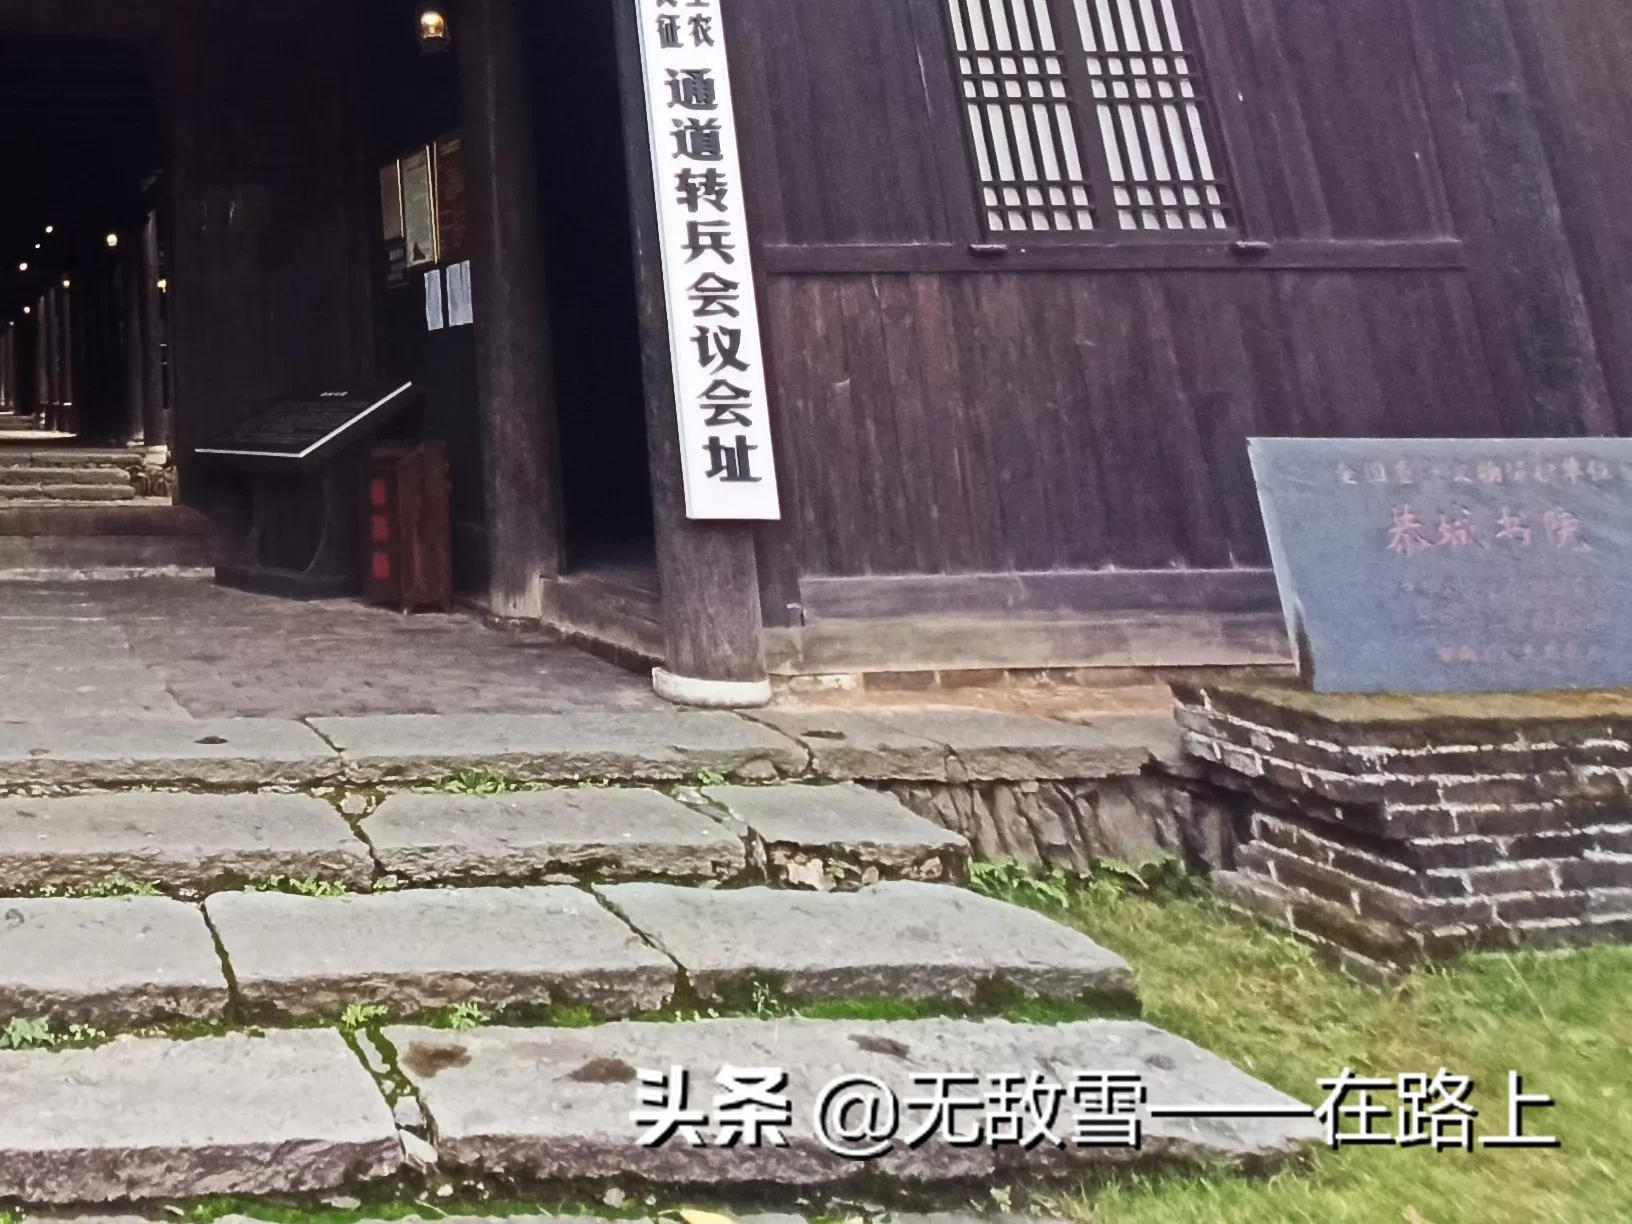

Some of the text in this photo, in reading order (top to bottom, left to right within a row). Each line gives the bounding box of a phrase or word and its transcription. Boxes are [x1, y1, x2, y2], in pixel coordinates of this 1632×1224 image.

[664, 68, 763, 483] 通道转兵会议会址
